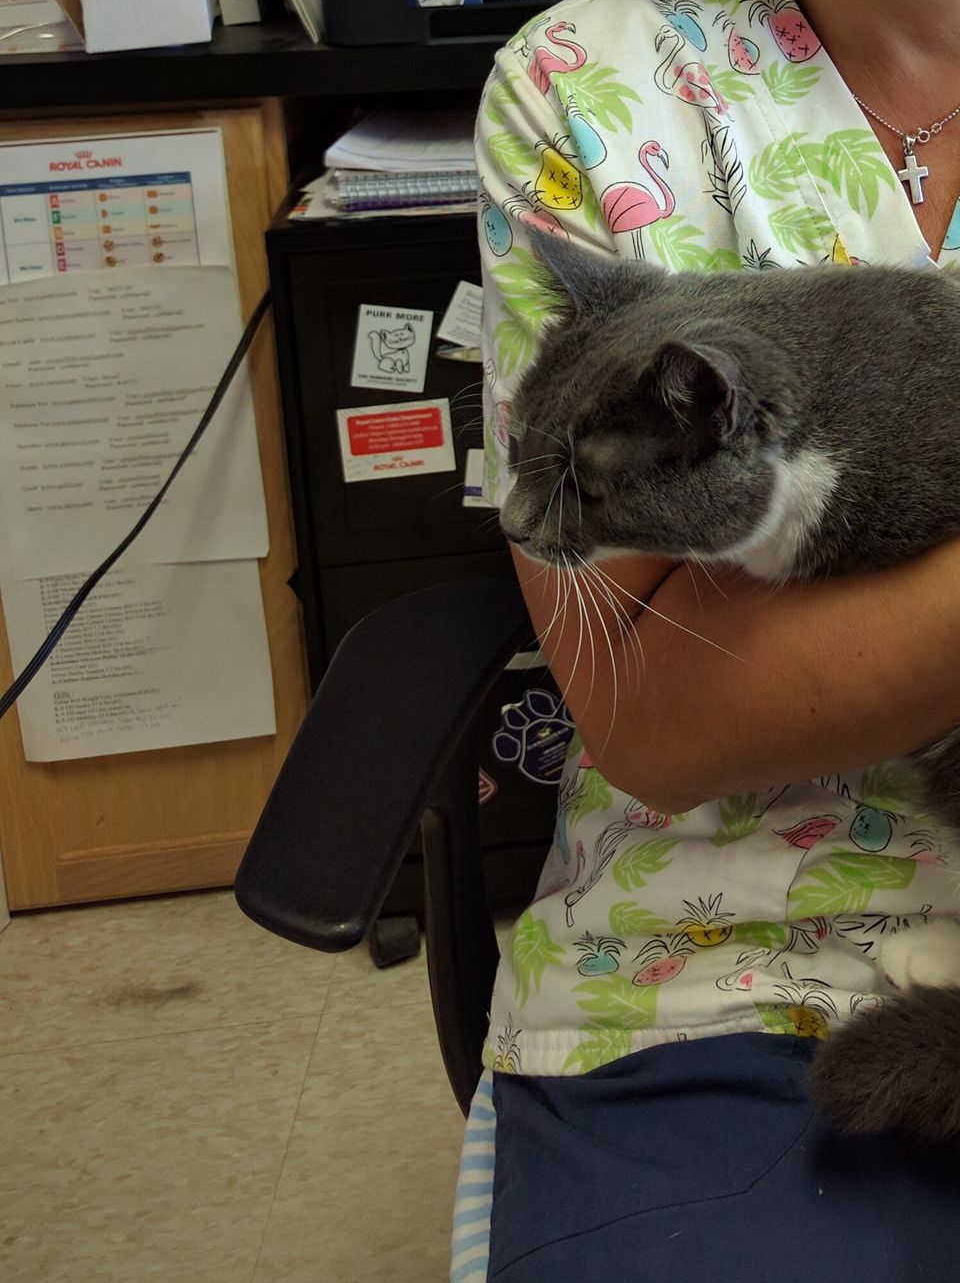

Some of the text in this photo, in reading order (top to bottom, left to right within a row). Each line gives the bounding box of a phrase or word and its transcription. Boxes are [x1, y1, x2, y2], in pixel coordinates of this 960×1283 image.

[49, 158, 122, 172] ROYAL CANIN
[366, 310, 424, 322] PURR MORE
